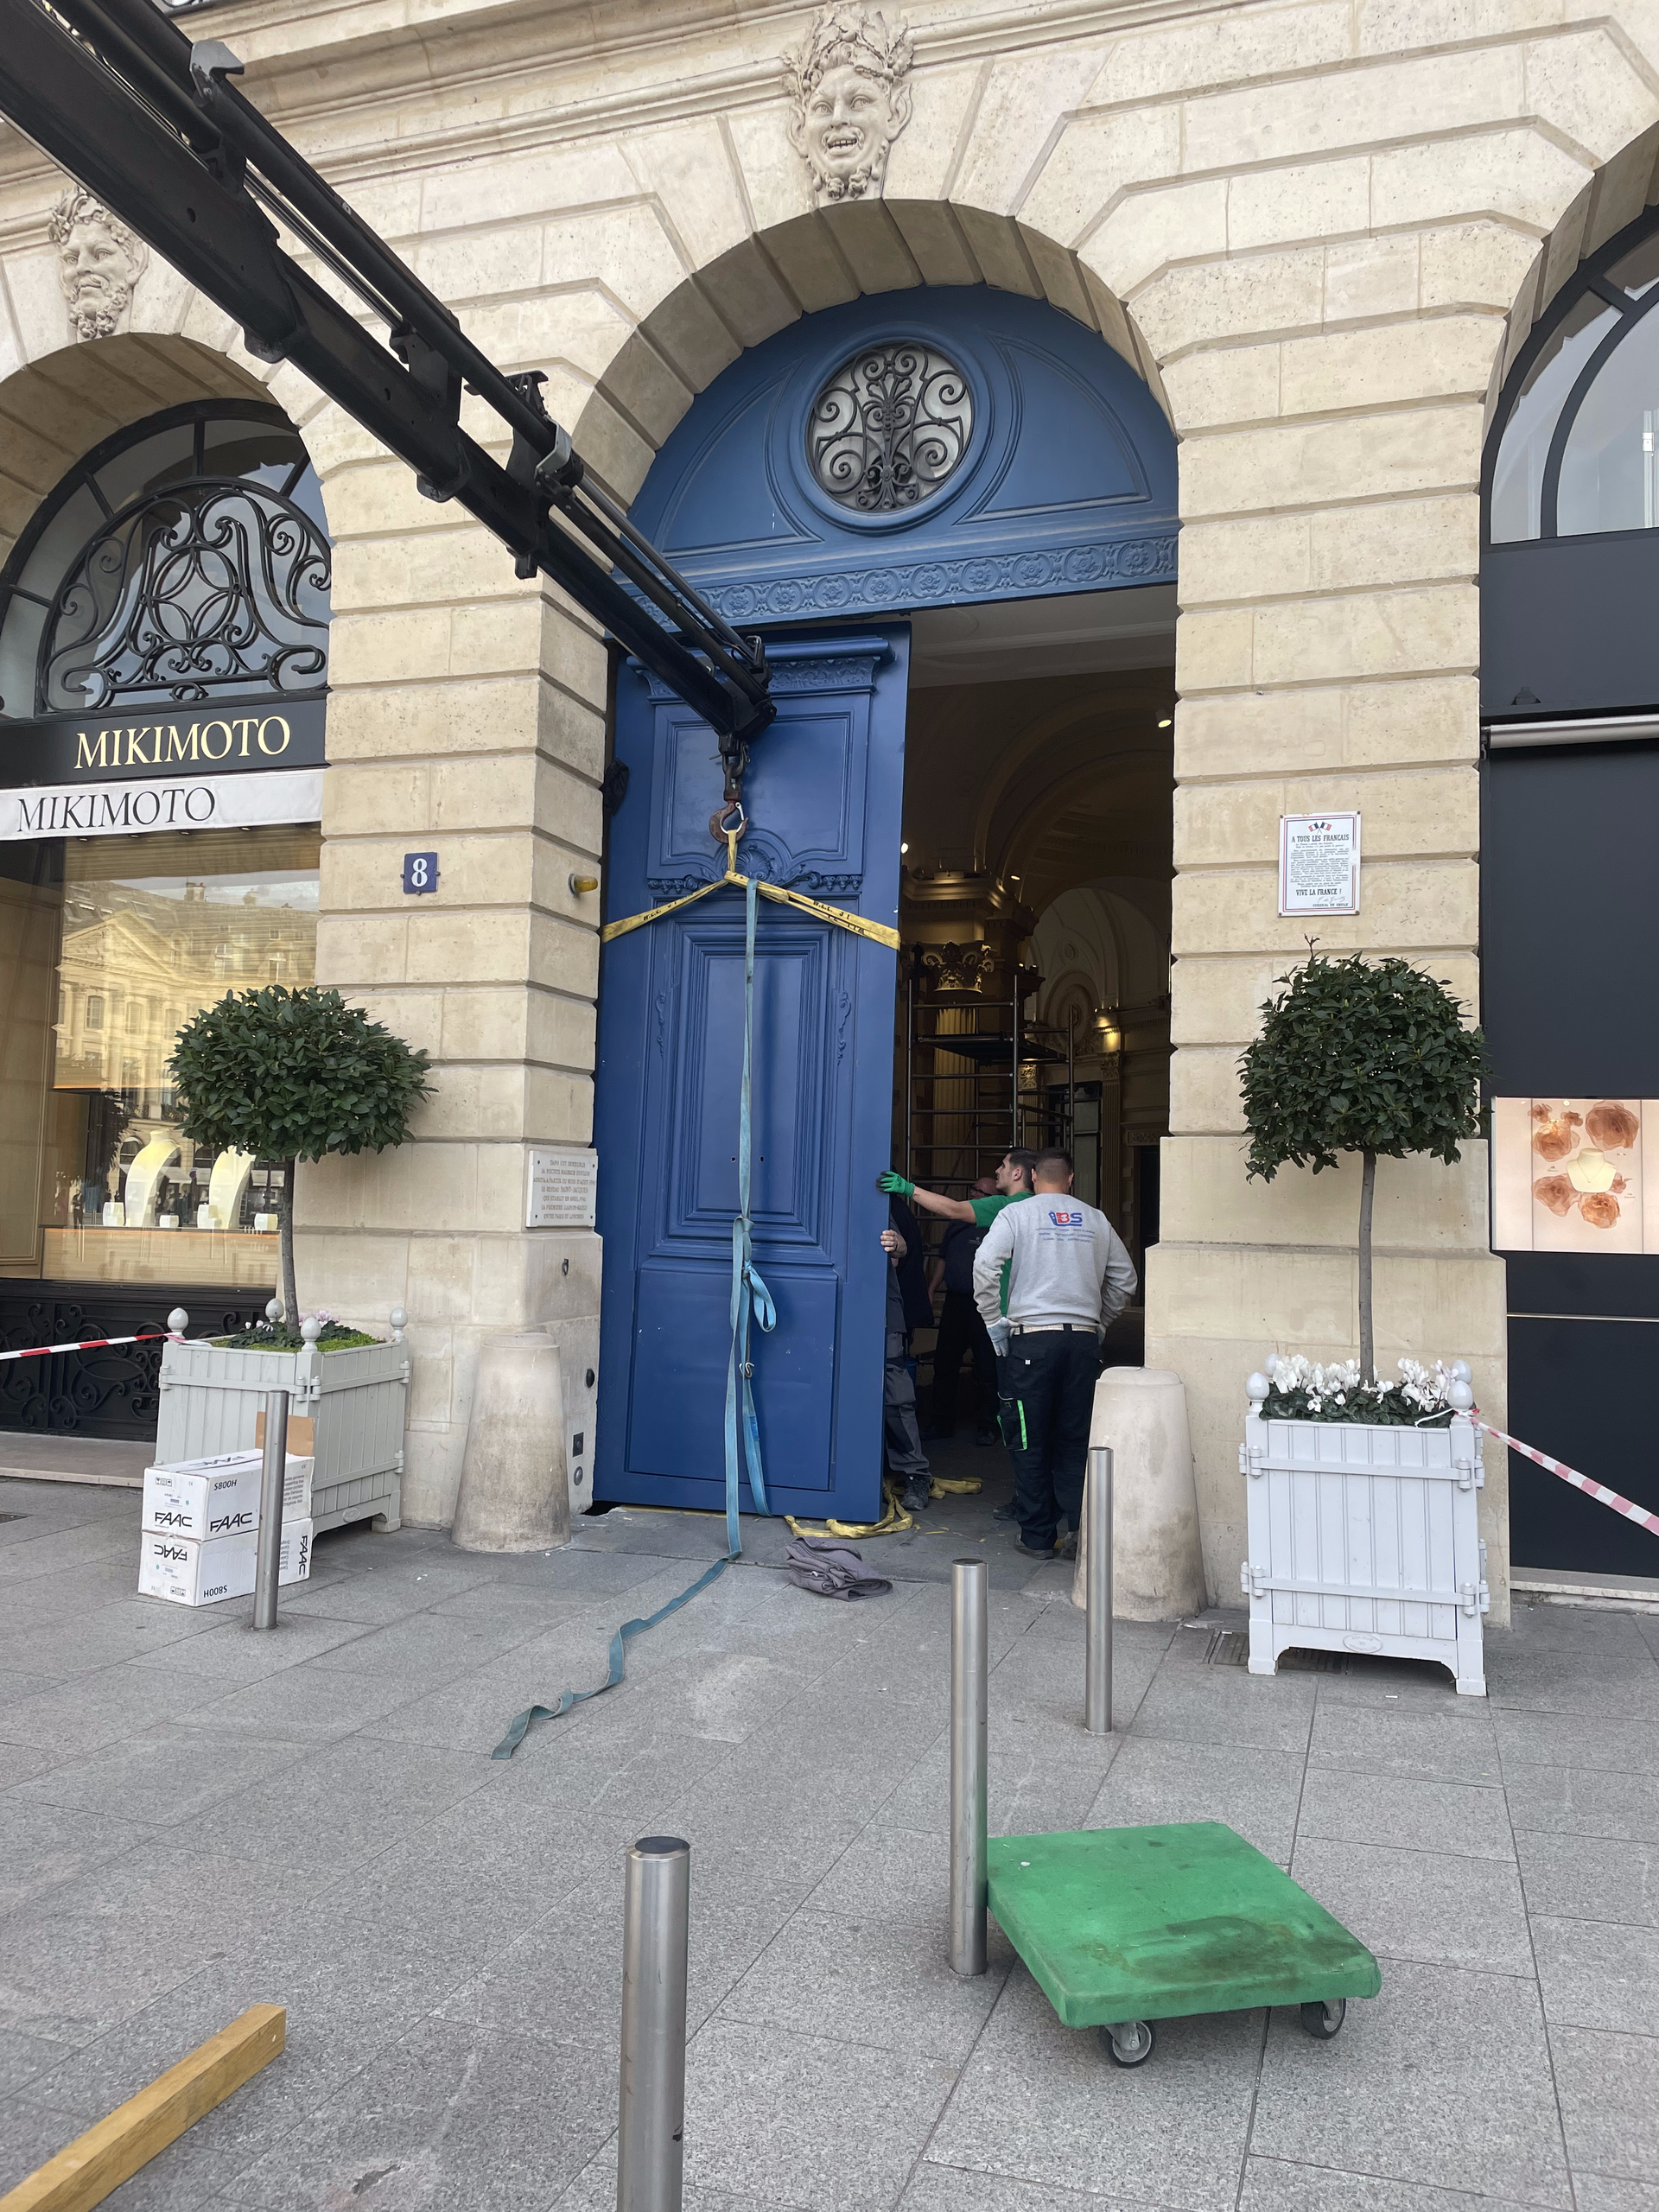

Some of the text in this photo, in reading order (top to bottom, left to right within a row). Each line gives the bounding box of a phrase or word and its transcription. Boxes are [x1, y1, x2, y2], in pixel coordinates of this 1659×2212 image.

[73, 715, 291, 770] MIKIMOTO
[16, 786, 216, 833] MIKIMOTO
[411, 858, 429, 887] 8
[213, 1479, 238, 1491] S800H
[155, 1512, 192, 1528] FAAC
[210, 1512, 252, 1533] FAAC
[154, 1544, 188, 1561] FAAC
[299, 1535, 308, 1576] FAAC
[203, 1585, 228, 1599] S800H
